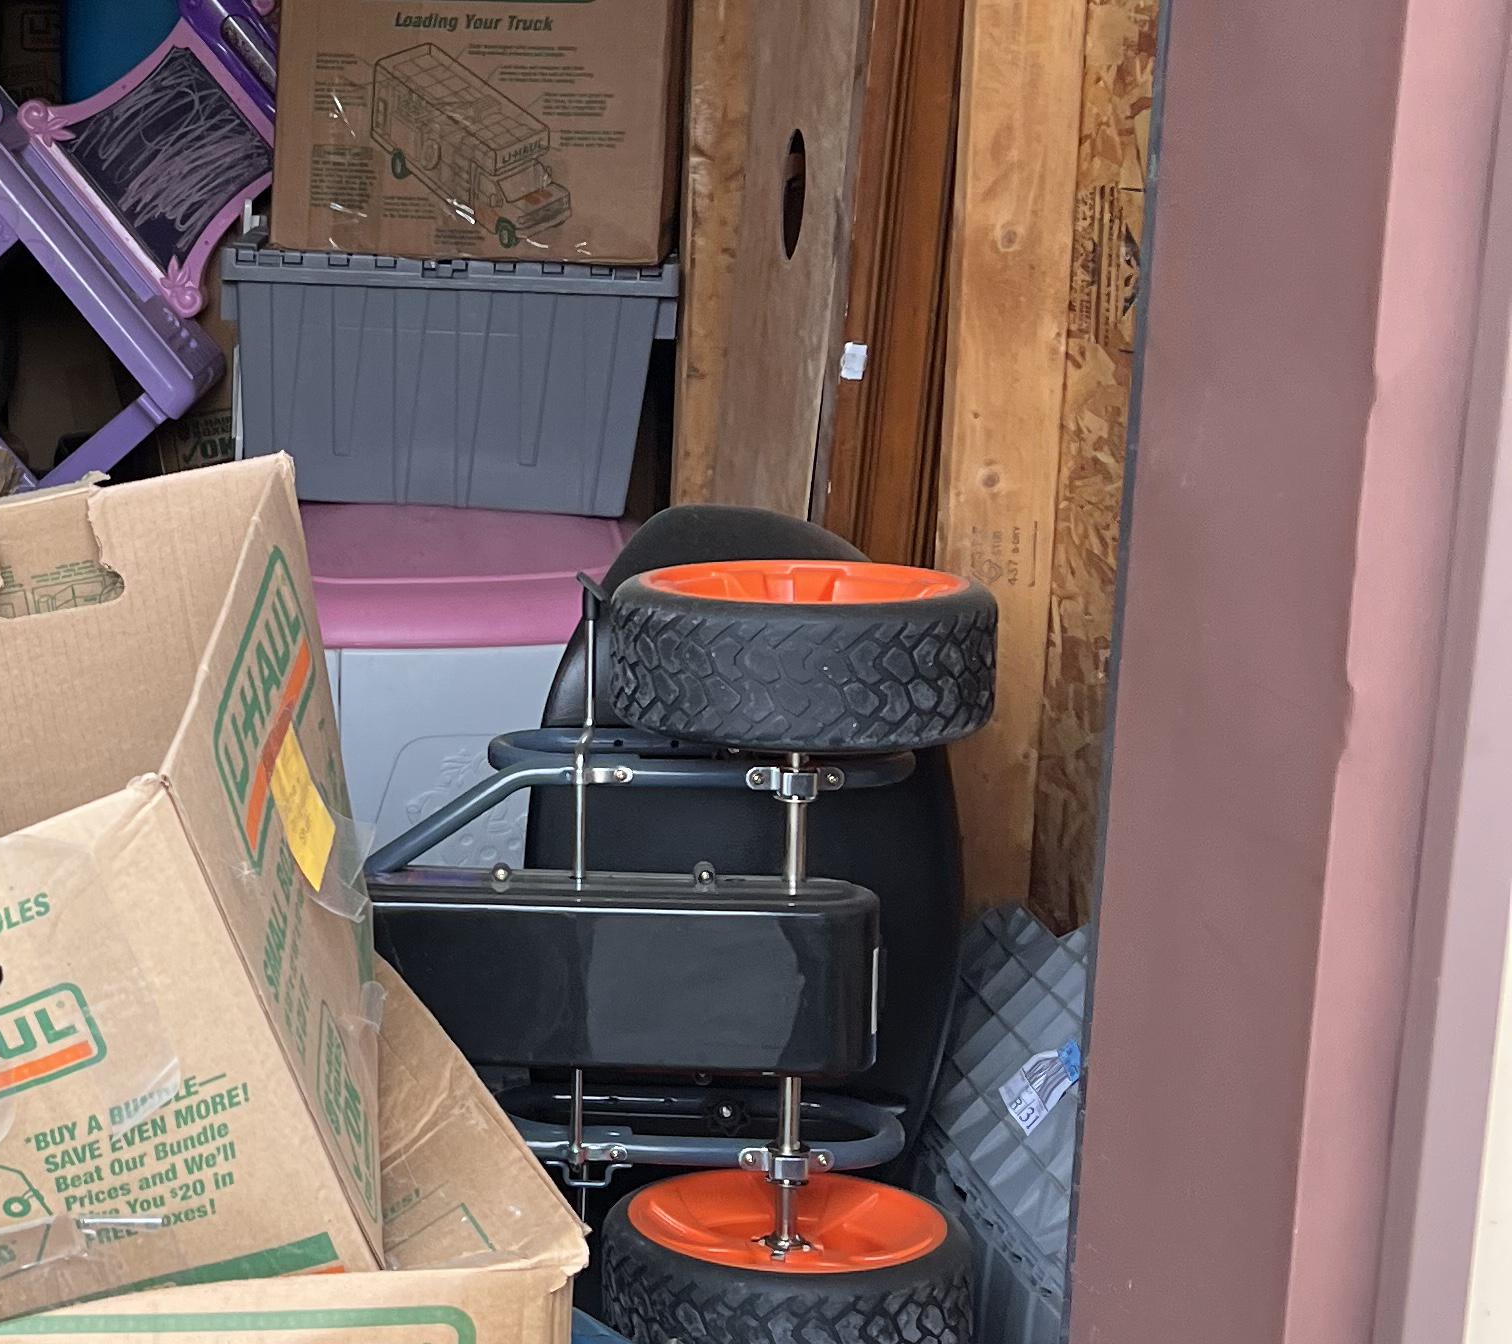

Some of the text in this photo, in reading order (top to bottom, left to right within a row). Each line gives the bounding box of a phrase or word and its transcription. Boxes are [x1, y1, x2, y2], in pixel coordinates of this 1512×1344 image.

[394, 11, 554, 33] Loading Your Truck
[224, 588, 301, 805] U-HAUL
[44, 1082, 249, 1174] SAVE EVEN MORE!
[55, 1122, 230, 1194] Beat Our Bundle
[87, 1114, 104, 1136] A
[65, 1141, 237, 1212] Prices and We'll
[125, 1171, 234, 1214] You $20 in
